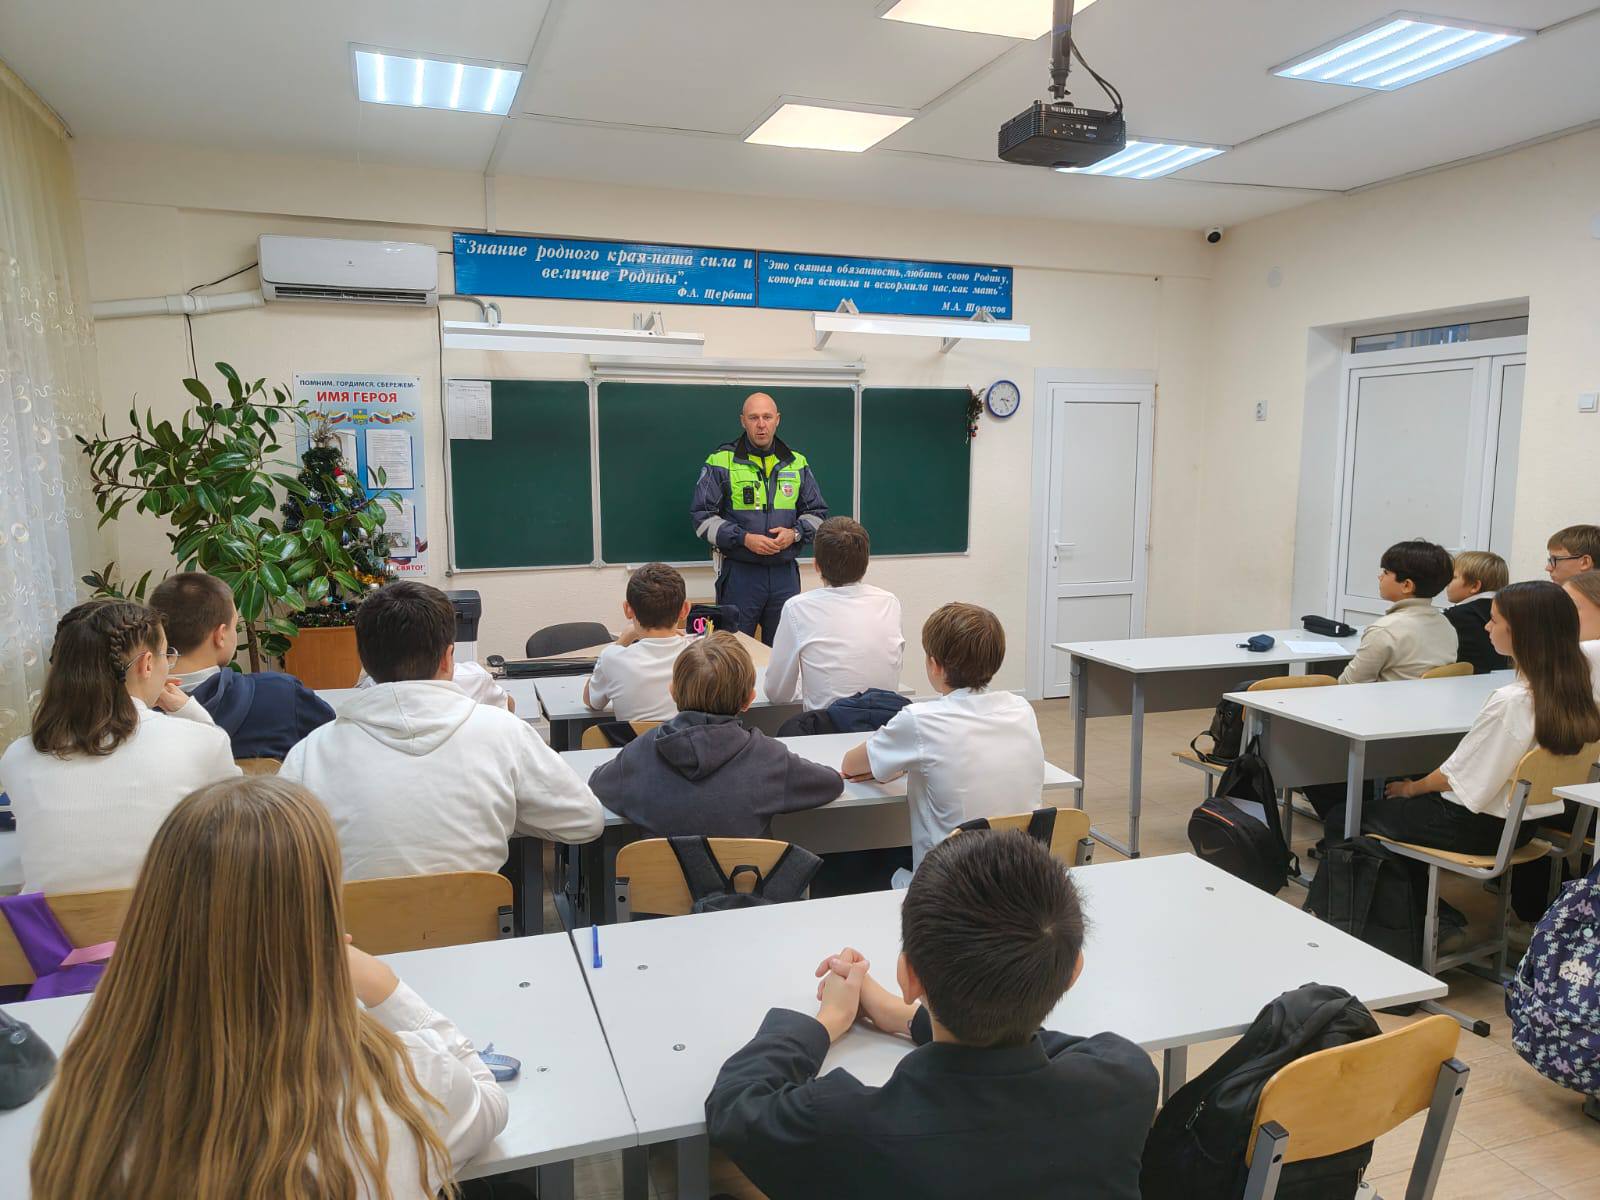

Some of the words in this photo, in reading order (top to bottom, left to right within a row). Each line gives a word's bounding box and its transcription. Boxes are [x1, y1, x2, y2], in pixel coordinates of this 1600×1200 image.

[535, 243, 599, 262] родного
[607, 249, 693, 267] края-наша
[700, 255, 736, 269] сила
[743, 257, 753, 270] и
[541, 266, 609, 282] величие
[794, 263, 833, 273] святая
[947, 272, 970, 282] свою
[973, 272, 1009, 286] Родину,
[768, 275, 814, 288] которая
[818, 279, 859, 289] вспоила
[874, 281, 928, 293] вскормила
[677, 286, 699, 299] Ф.А.
[704, 288, 753, 302] Щербина
[941, 301, 961, 312] М.А.
[317, 391, 349, 402] ИМЯ
[353, 391, 397, 403] ГЕРОЯ
[1558, 968, 1590, 987] Kappa
